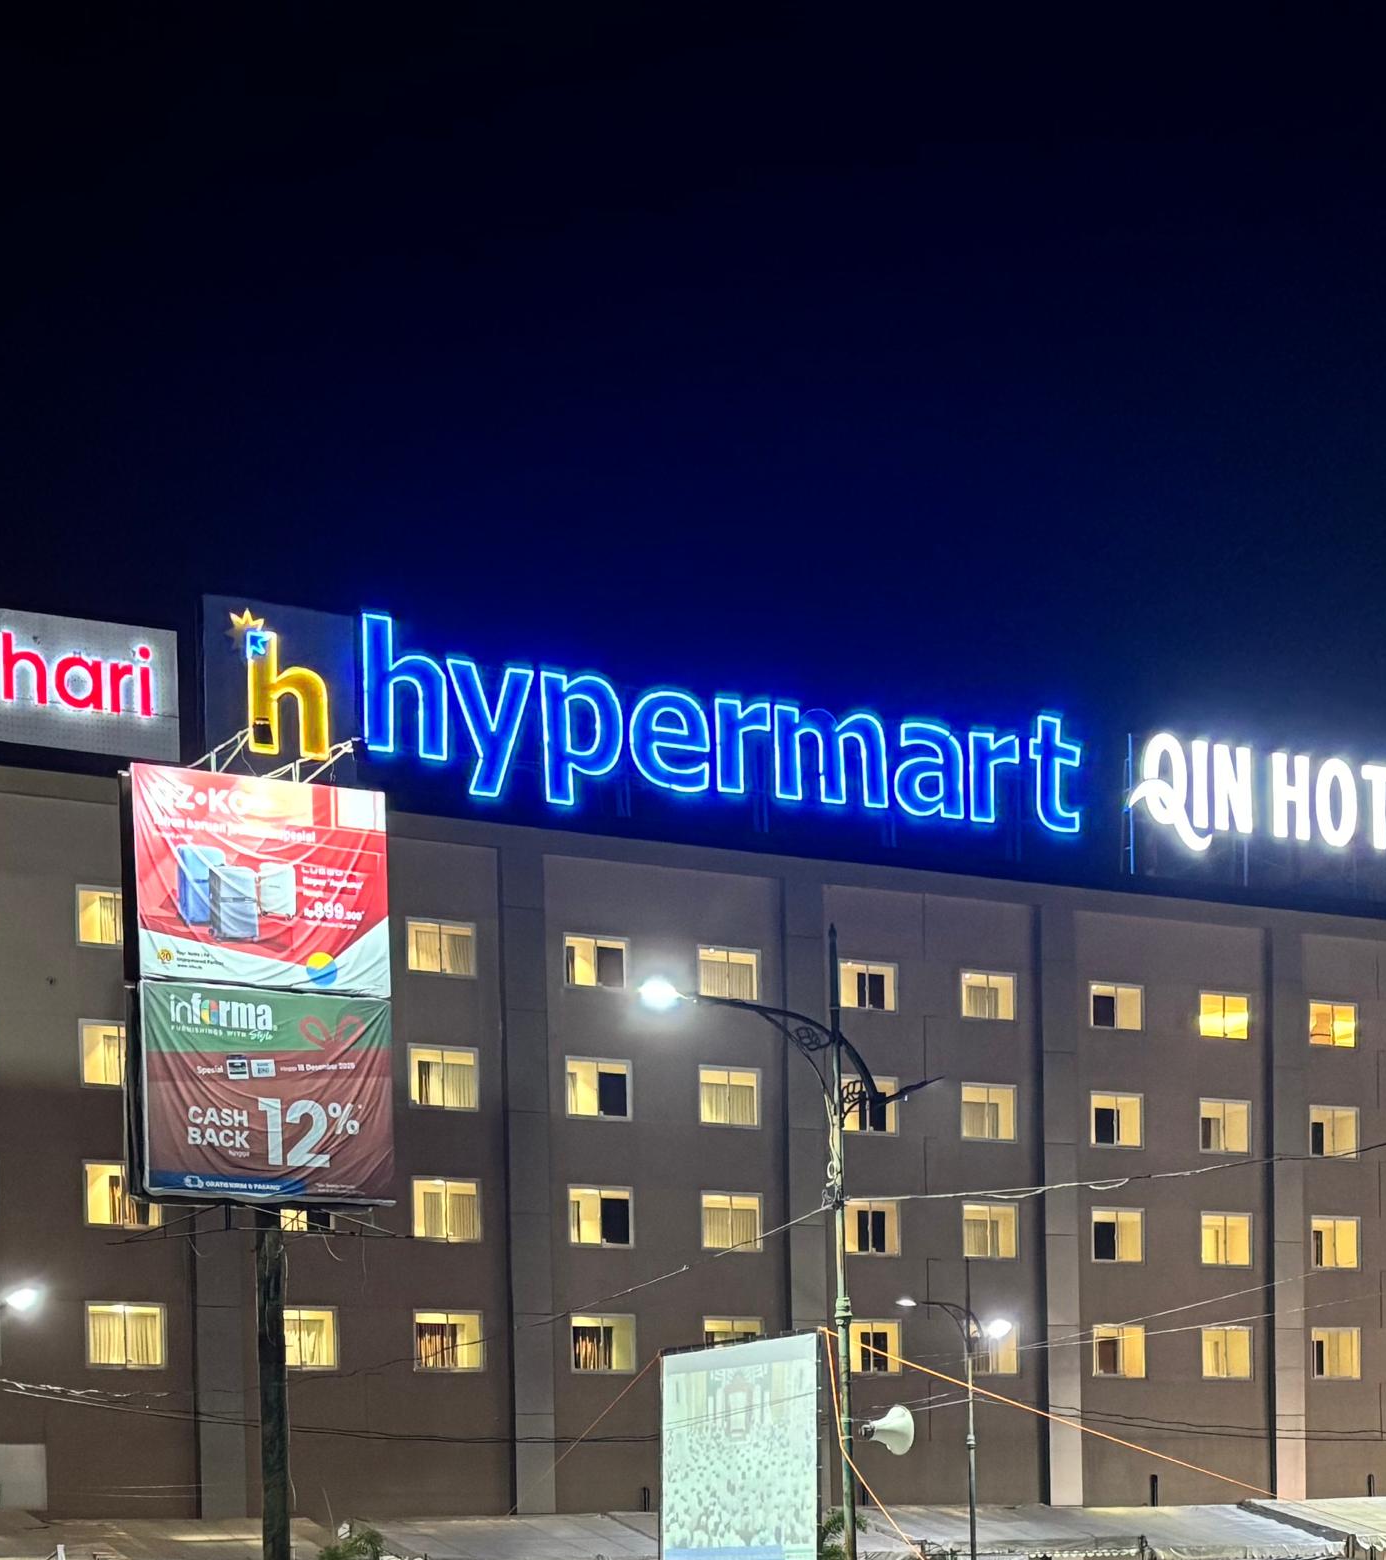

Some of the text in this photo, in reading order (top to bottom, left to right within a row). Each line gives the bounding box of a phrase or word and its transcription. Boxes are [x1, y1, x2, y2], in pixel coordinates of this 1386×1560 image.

[361, 611, 1081, 834] hypermart
[1129, 731, 1253, 851] QIN
[170, 992, 273, 1031] informa
[249, 1028, 273, 1042] Style
[188, 1106, 249, 1128] CASH
[187, 1126, 249, 1149] BACK
